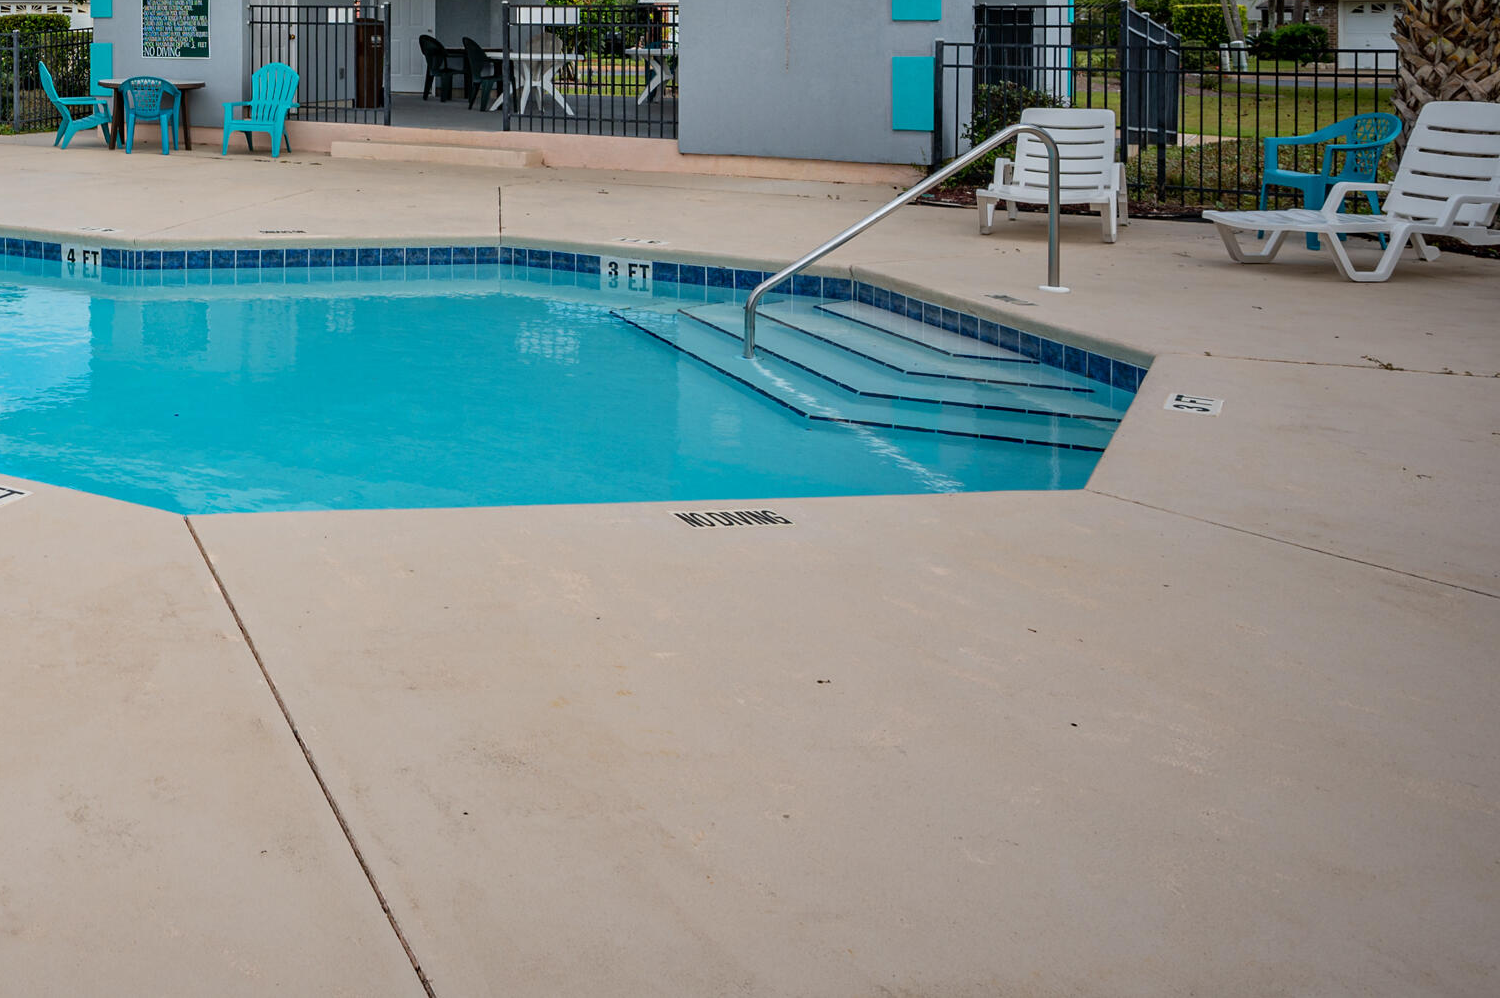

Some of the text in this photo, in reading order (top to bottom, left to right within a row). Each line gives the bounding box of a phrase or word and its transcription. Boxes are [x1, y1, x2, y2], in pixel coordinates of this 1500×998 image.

[144, 46, 181, 57] NO DIVING
[67, 248, 99, 266] 4 FT
[608, 261, 650, 279] 3 FT
[1172, 394, 1215, 412] 3 FT
[673, 510, 794, 528] NO DIVING
